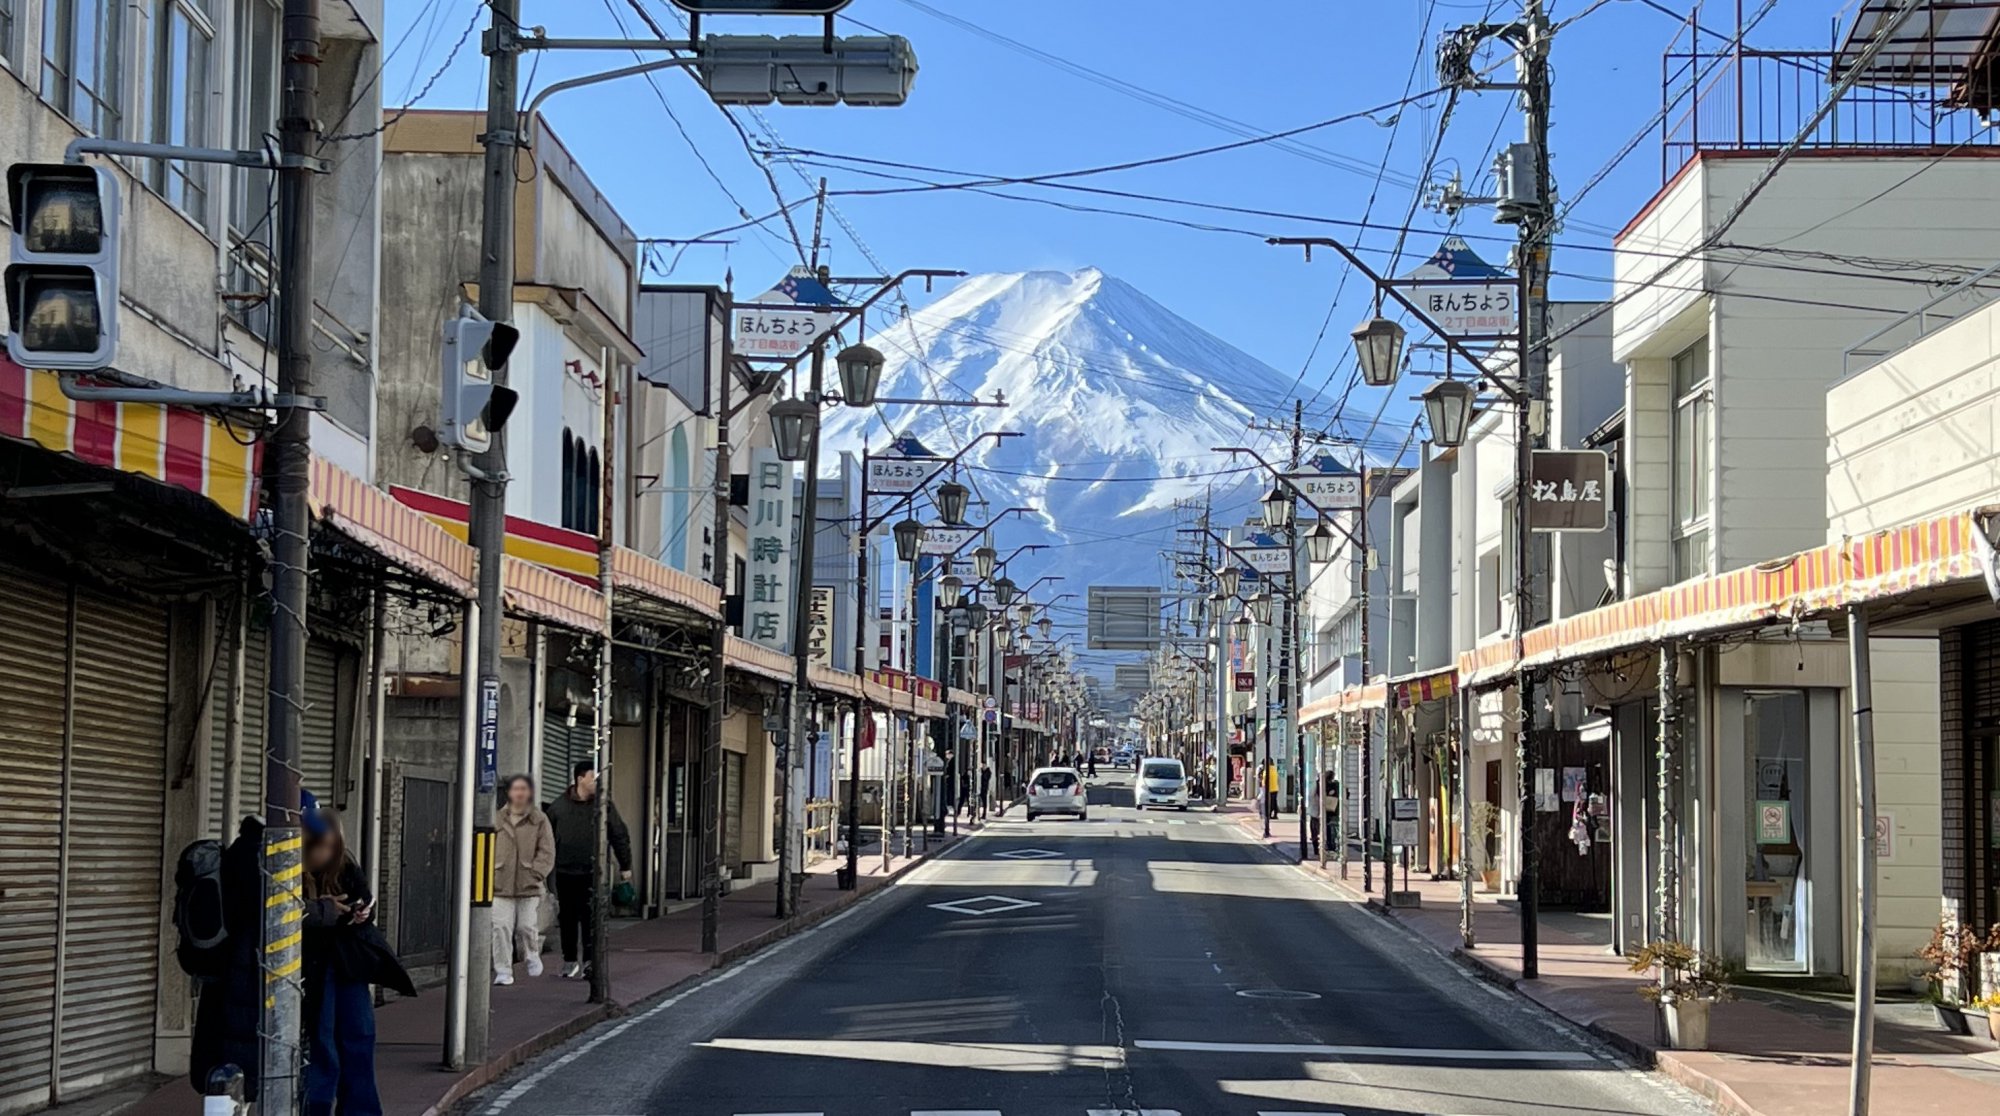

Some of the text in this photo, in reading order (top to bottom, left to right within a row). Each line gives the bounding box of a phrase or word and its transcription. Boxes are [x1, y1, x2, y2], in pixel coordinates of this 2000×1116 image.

[1429, 292, 1510, 312] ほんちょう
[740, 316, 816, 335] ほんちょう
[873, 464, 925, 478] ほんちょう
[1306, 481, 1356, 494] ほんちょう
[1532, 479, 1602, 502] 松島屋
[751, 462, 783, 641] 日川時計店
[486, 753, 493, 766] 1
